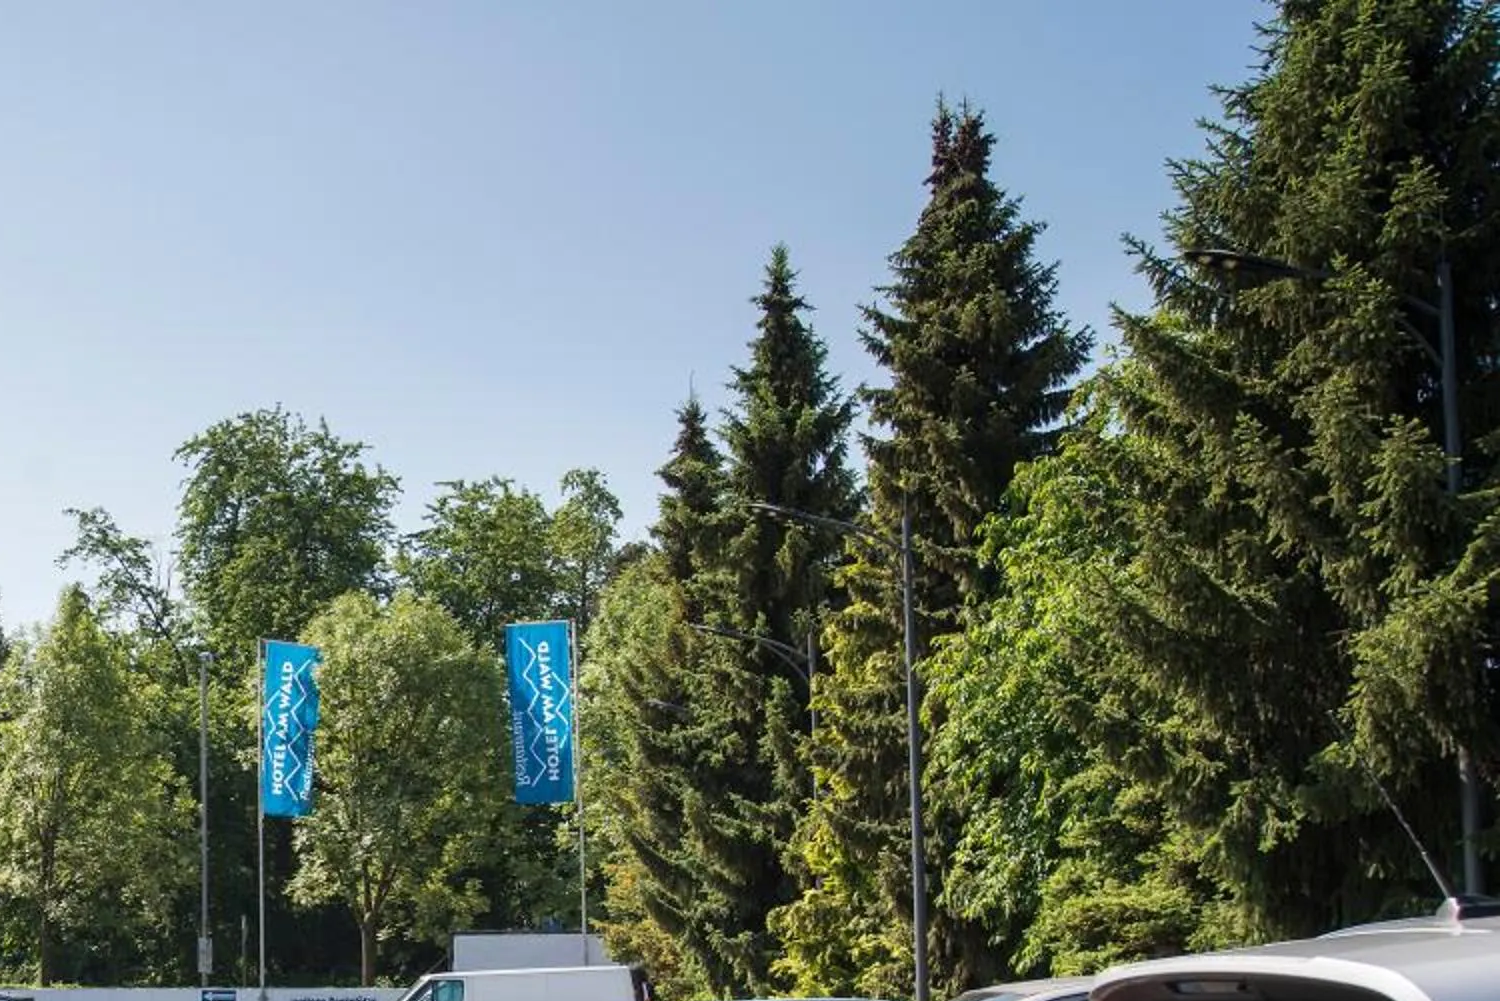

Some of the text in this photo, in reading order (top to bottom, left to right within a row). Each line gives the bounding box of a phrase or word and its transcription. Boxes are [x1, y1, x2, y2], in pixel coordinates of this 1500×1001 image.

[271, 661, 293, 795] HOTEL AM WALD
